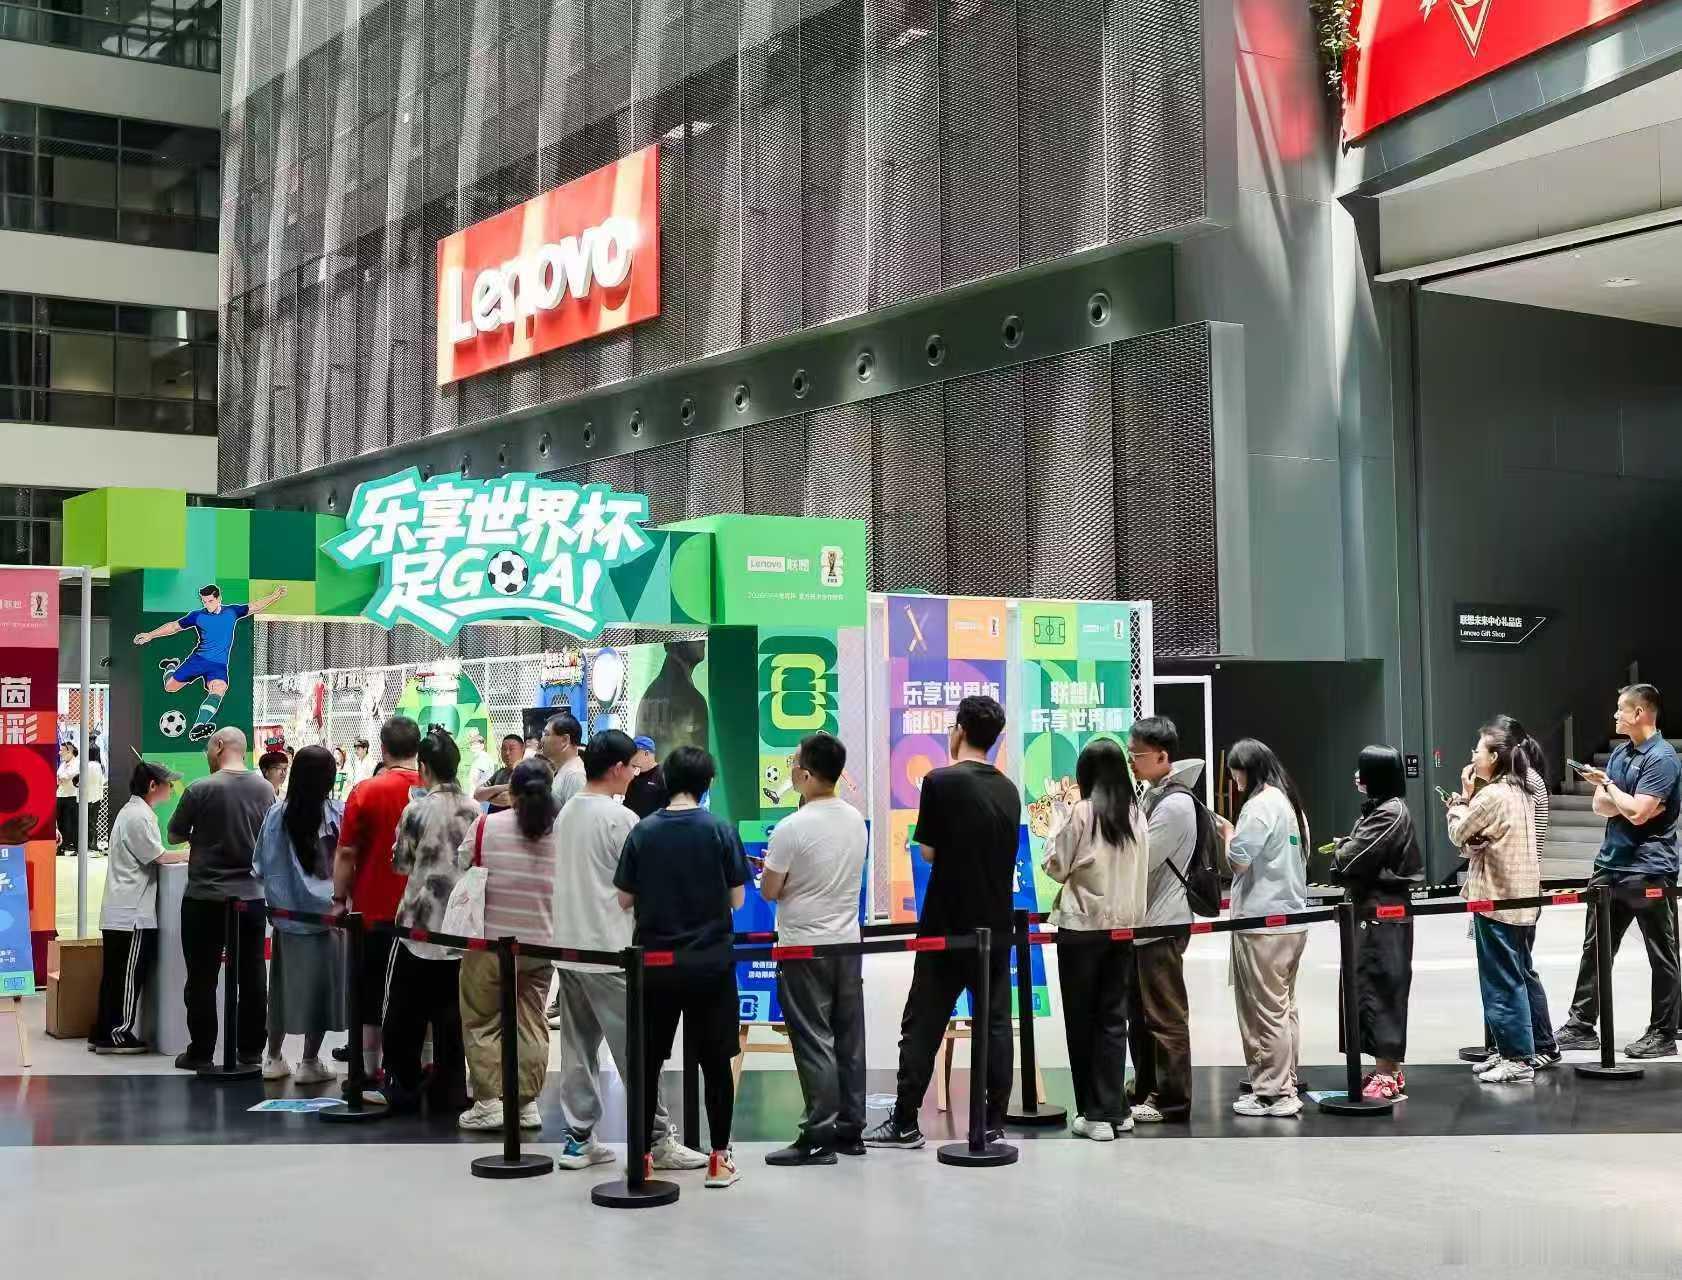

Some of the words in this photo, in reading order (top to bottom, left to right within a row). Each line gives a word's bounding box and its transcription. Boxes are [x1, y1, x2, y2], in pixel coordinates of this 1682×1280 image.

[448, 216, 638, 344] Lenovo
[336, 477, 645, 561] 乐享世界杯
[0, 713, 38, 744] 彩
